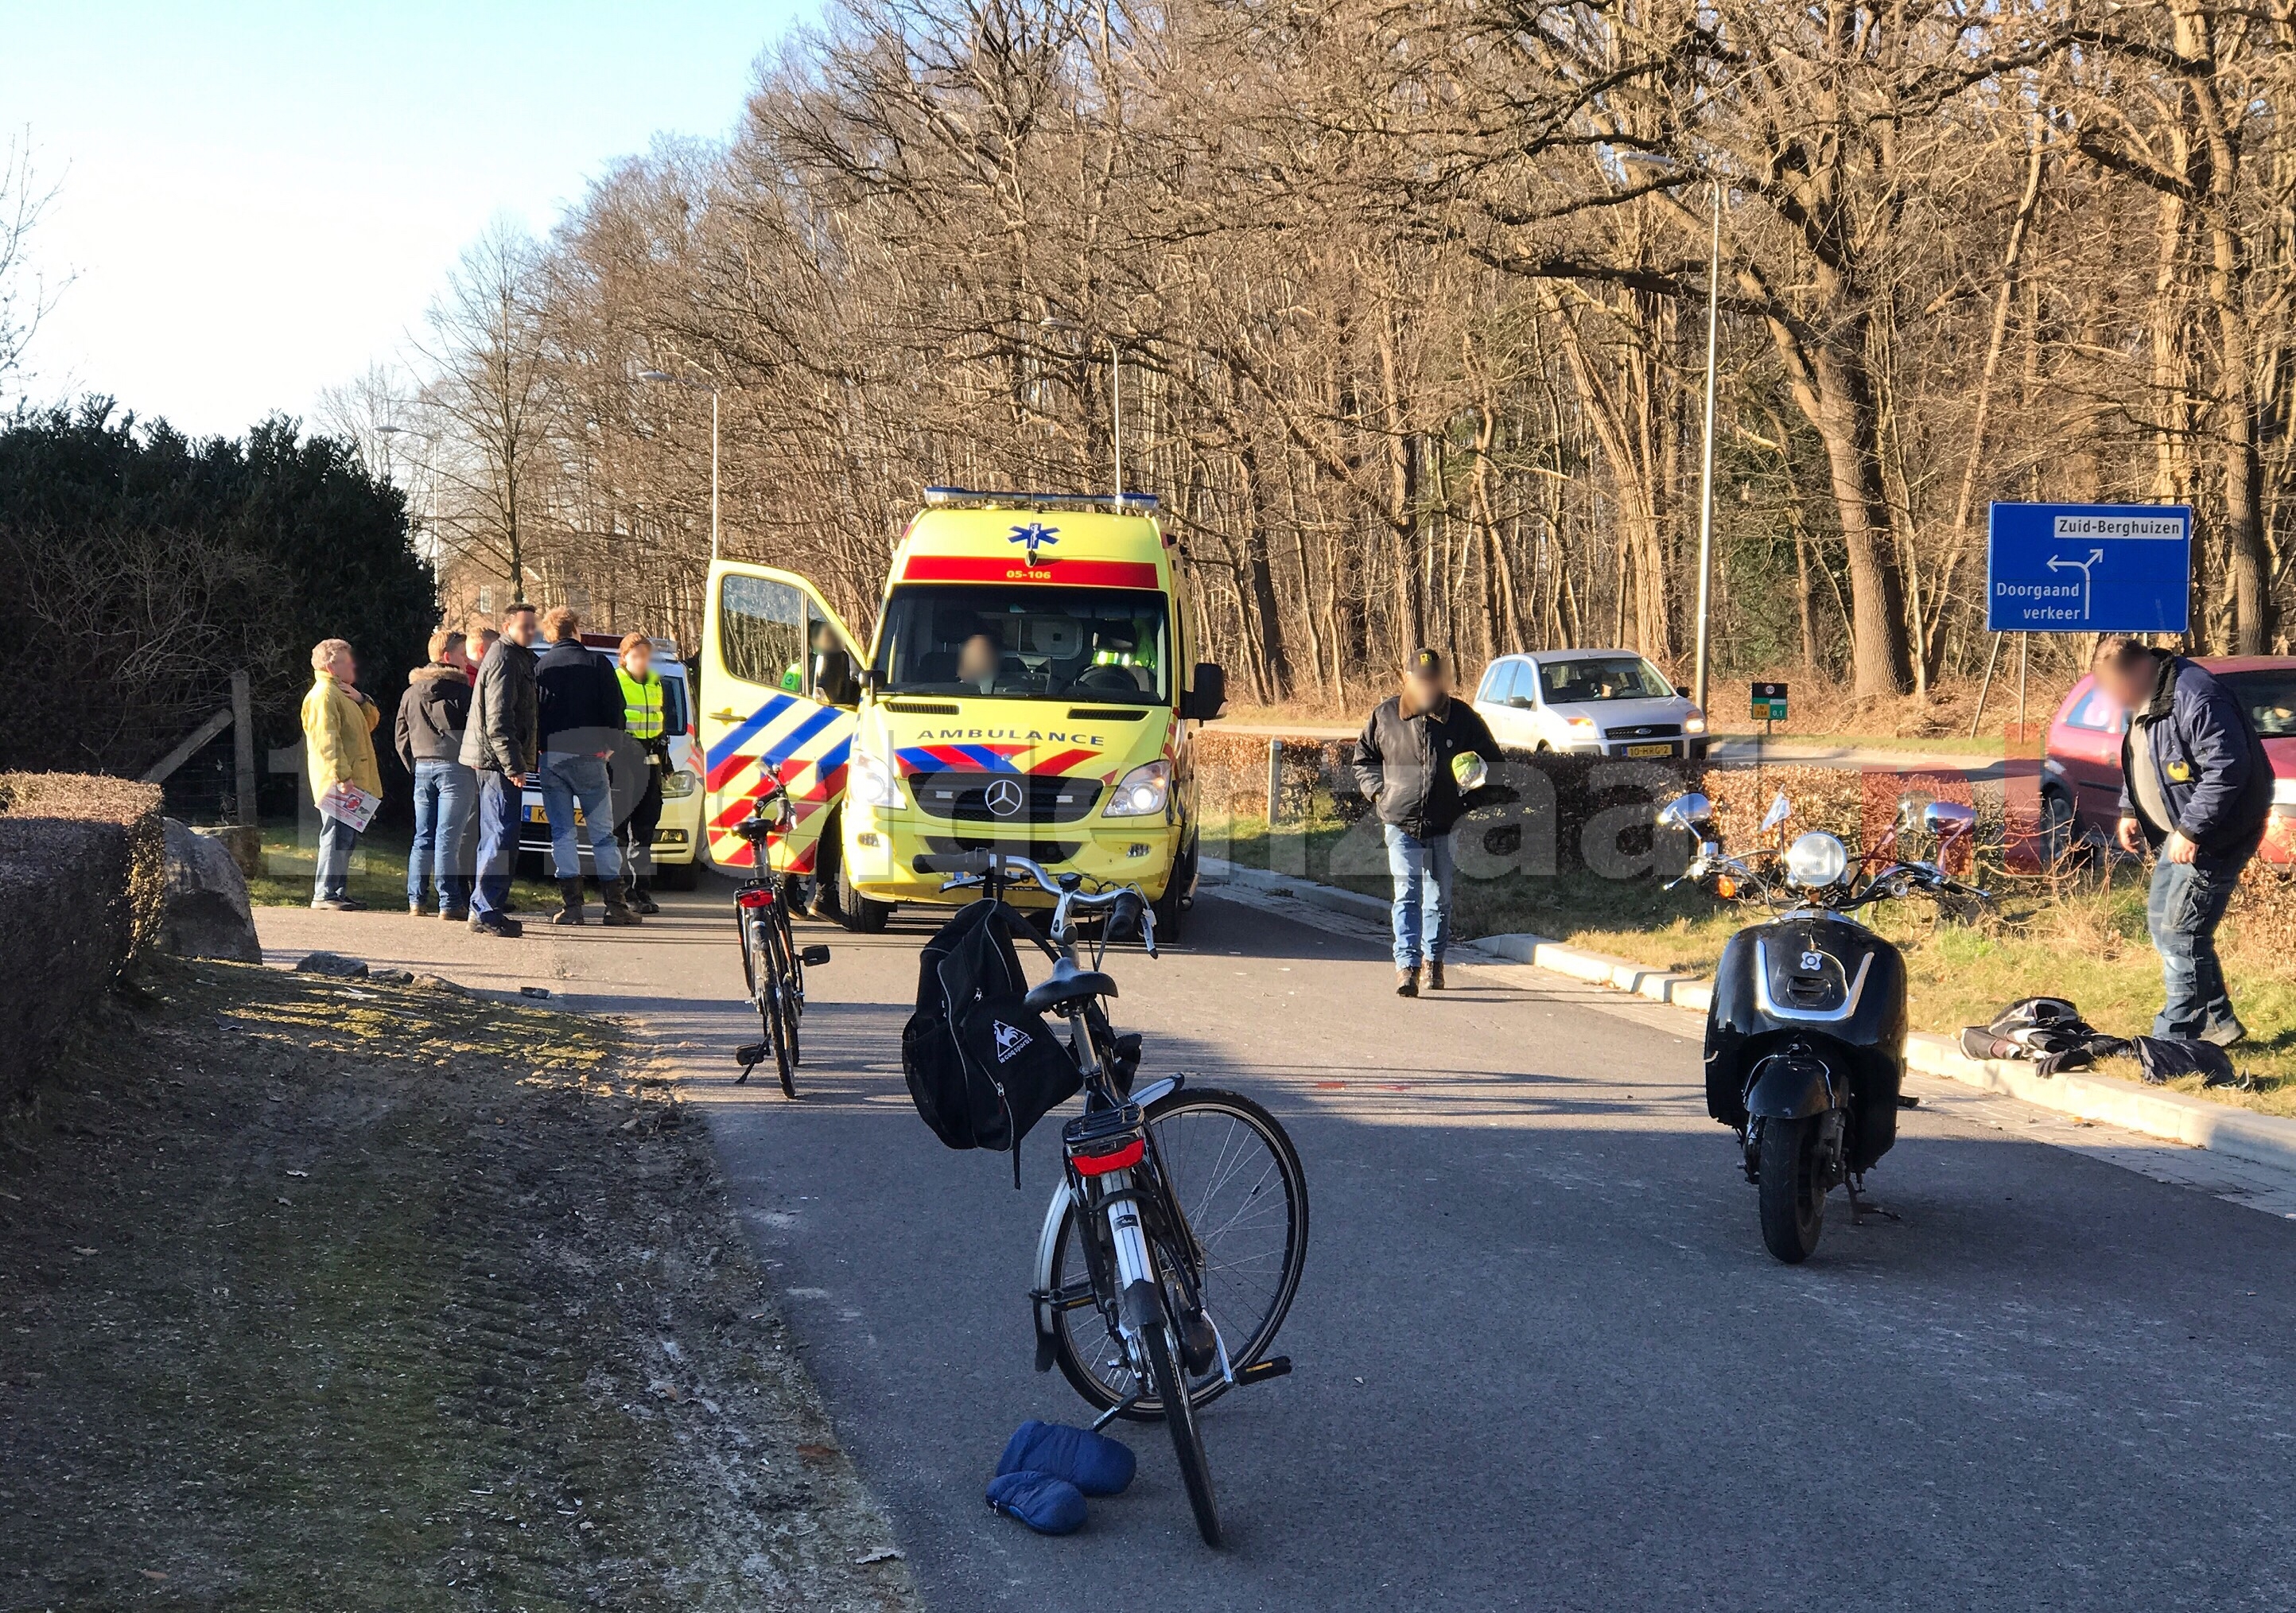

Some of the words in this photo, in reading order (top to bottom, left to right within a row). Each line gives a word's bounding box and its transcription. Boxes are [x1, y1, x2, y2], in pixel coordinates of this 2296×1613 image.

[2059, 519, 2179, 537] Zuid-Berghuizen
[1006, 570, 1051, 579] 05-106
[1997, 583, 2079, 600] Doorgaand
[2023, 606, 2080, 620] verkeer
[917, 729, 1105, 746] AMBULANCE
